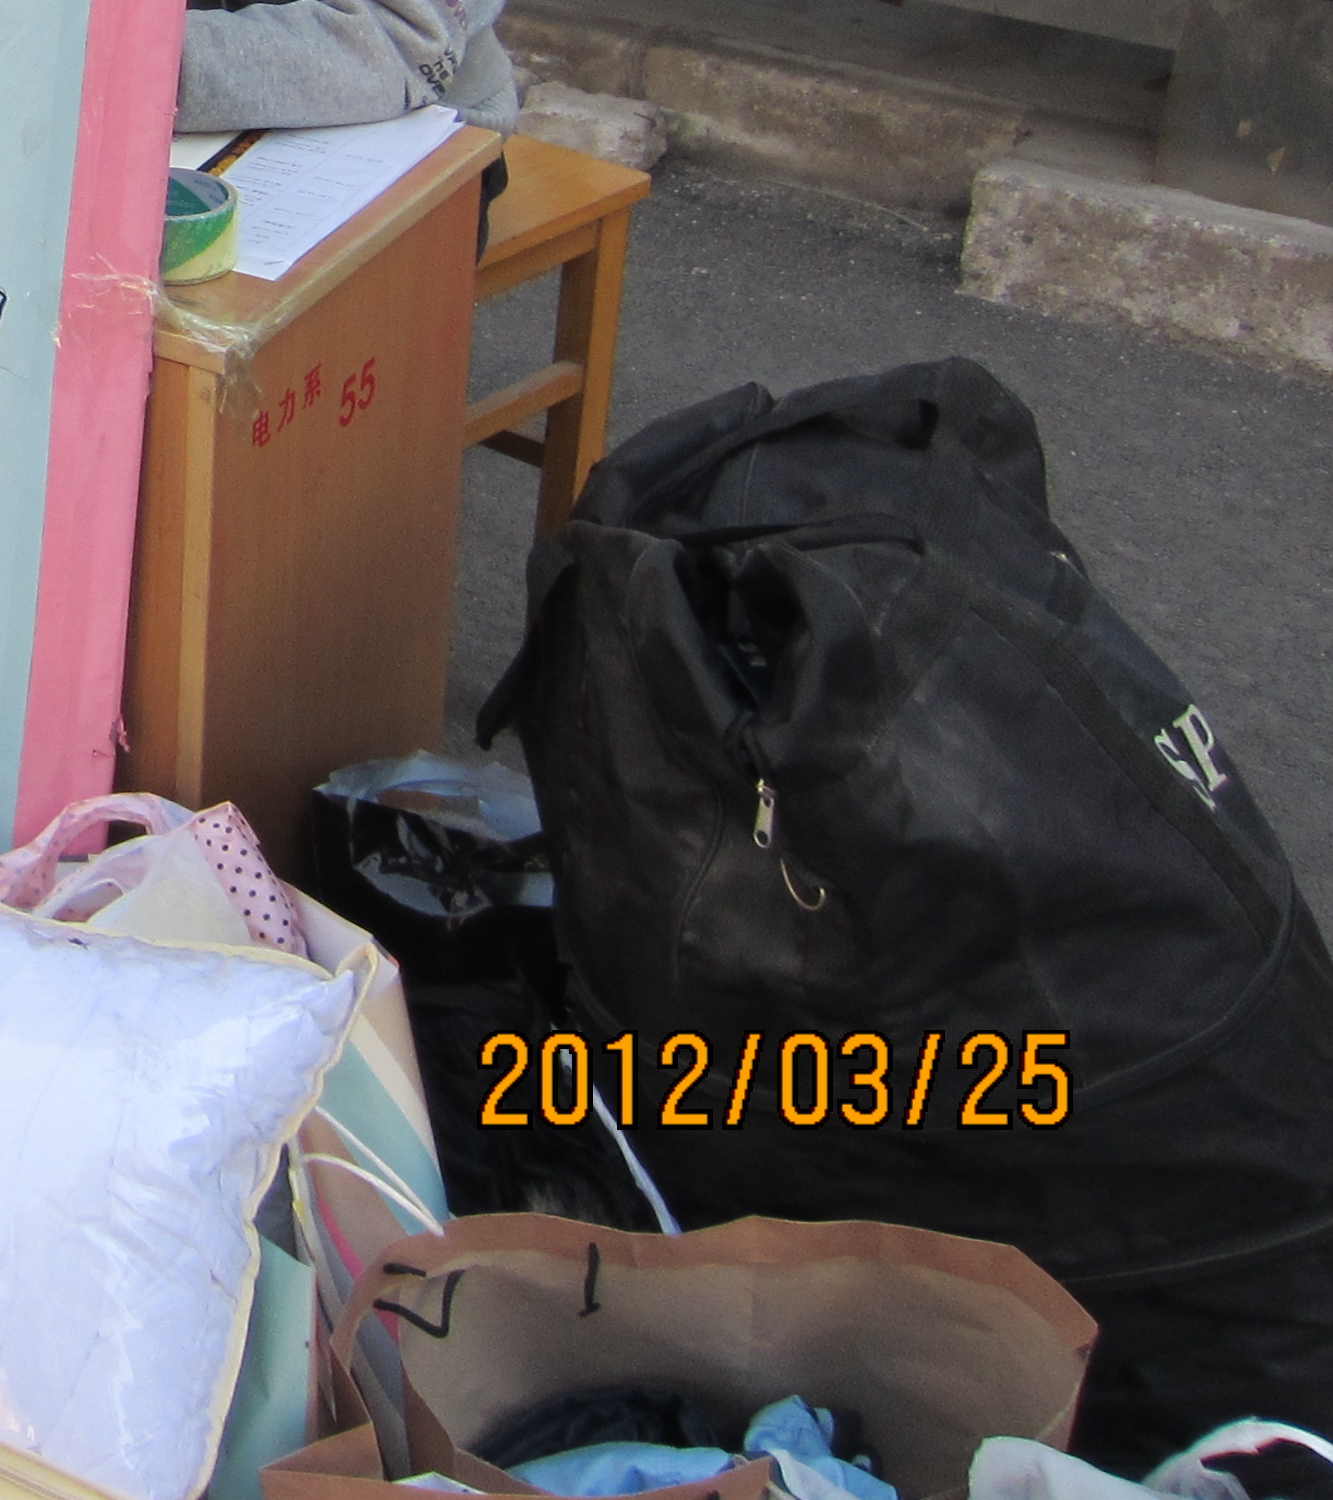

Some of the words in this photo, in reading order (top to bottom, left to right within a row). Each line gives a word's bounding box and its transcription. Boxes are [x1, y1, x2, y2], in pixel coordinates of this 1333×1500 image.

[251, 362, 324, 448] 电力系
[338, 356, 378, 428] 55
